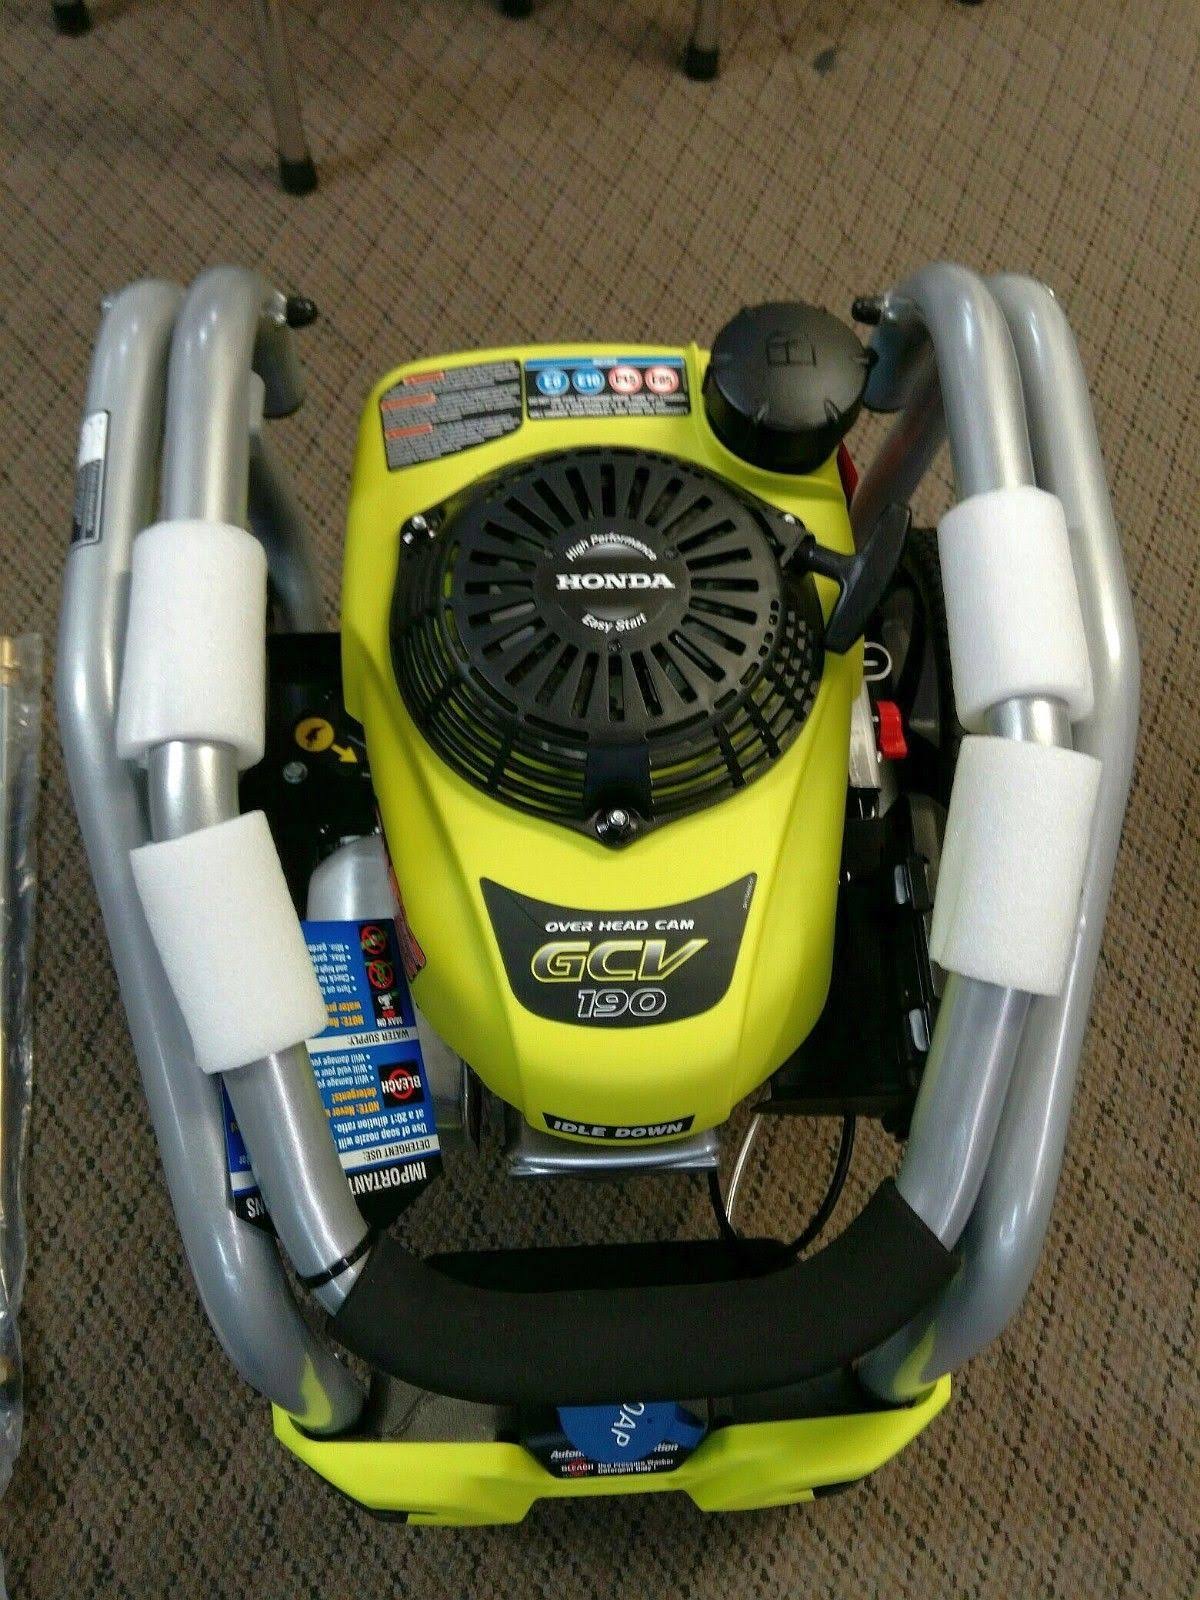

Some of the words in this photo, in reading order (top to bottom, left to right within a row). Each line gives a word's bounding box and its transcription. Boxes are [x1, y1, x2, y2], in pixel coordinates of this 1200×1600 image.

[565, 539, 589, 562] High
[590, 533, 657, 561] Performance
[556, 572, 675, 590] HONDA
[581, 613, 613, 633] Easy
[615, 612, 647, 632] Start
[545, 921, 593, 932] OVER
[599, 920, 648, 931] HEAD
[655, 919, 695, 931] CAM
[309, 942, 326, 953] garde
[531, 938, 709, 983] GCV
[329, 973, 350, 982] Check
[339, 1000, 361, 1011] water
[577, 988, 667, 1018] 190
[382, 1029, 410, 1042] WATER
[322, 1053, 351, 1065] damage
[352, 1053, 366, 1064] Will
[319, 1066, 336, 1077] your
[337, 1065, 351, 1076] void
[353, 1063, 367, 1074] Will
[326, 1075, 353, 1087] damage
[354, 1075, 369, 1085] Will
[381, 1074, 421, 1094] BLEACH
[331, 1087, 377, 1104] detergents!
[329, 1104, 355, 1117] Never
[356, 1101, 380, 1114] NOTE:
[415, 1108, 424, 1119] at
[357, 1115, 388, 1130] dilution
[390, 1113, 407, 1125] 20:1
[334, 1121, 356, 1133] ratio.
[381, 1127, 400, 1140] soap
[402, 1127, 410, 1137] of
[411, 1123, 427, 1136] Use
[554, 1120, 605, 1137] IDLE
[615, 1122, 682, 1138] DOWN
[338, 1136, 353, 1150] will
[354, 1131, 380, 1146] nozzle
[384, 1139, 430, 1159] DETERGENT
